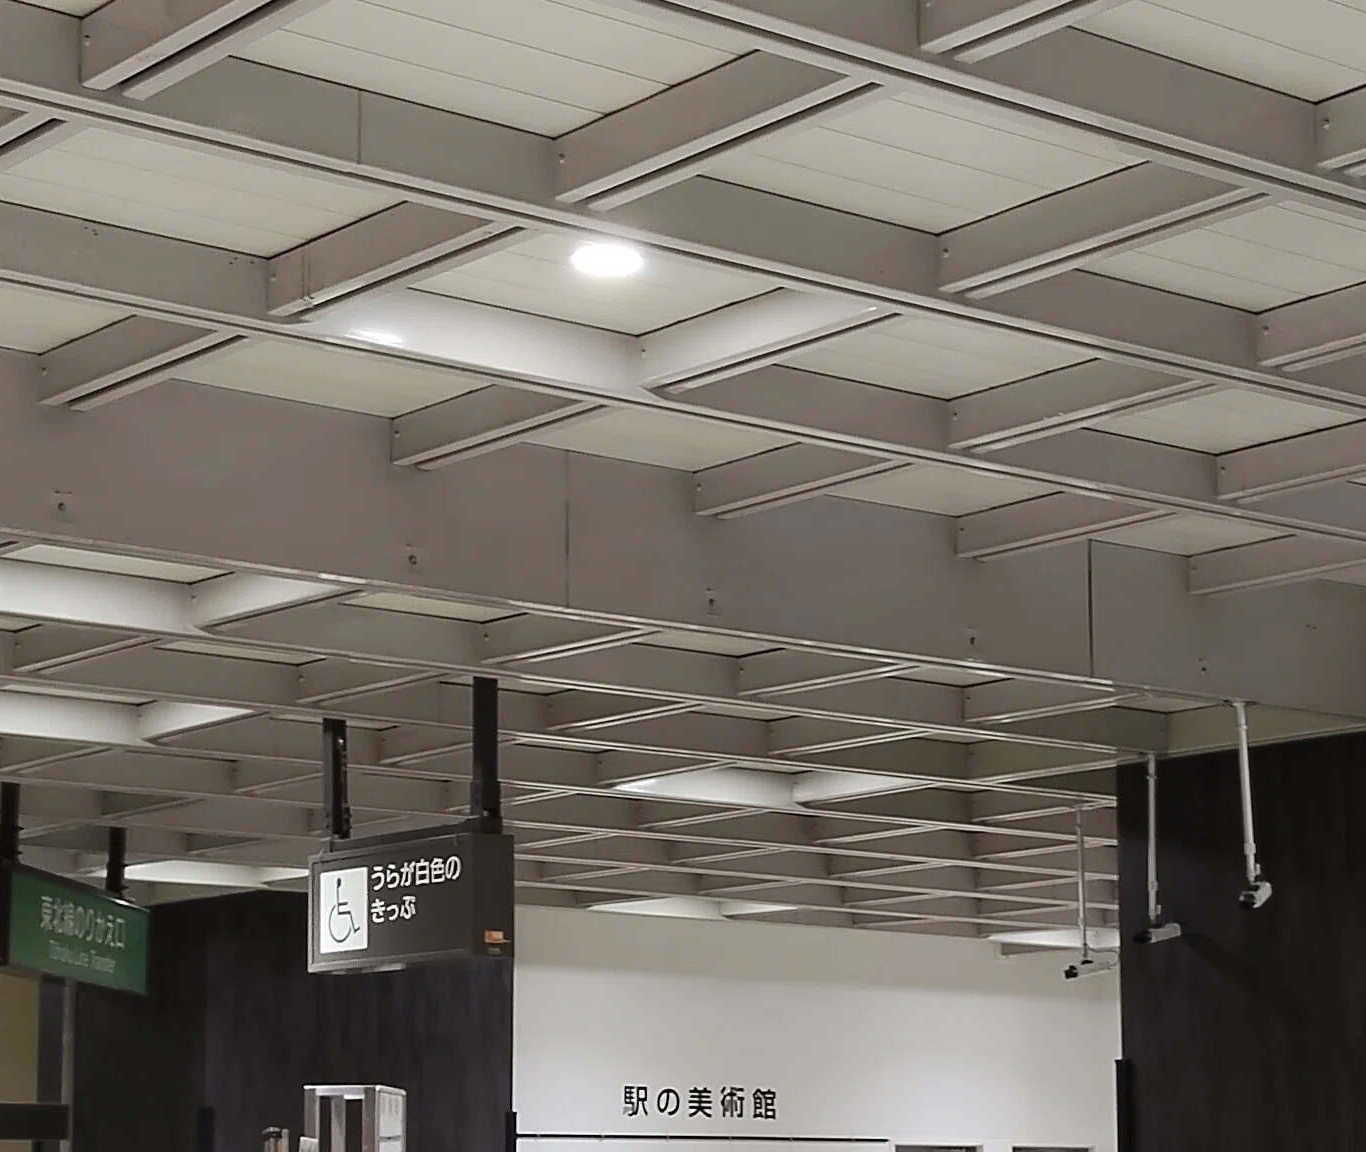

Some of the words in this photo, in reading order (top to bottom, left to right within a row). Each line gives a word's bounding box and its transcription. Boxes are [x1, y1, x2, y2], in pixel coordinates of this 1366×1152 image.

[370, 854, 461, 893] うらが白色の
[370, 894, 417, 925] きっぷ
[622, 1085, 778, 1121] 駅の美術館
